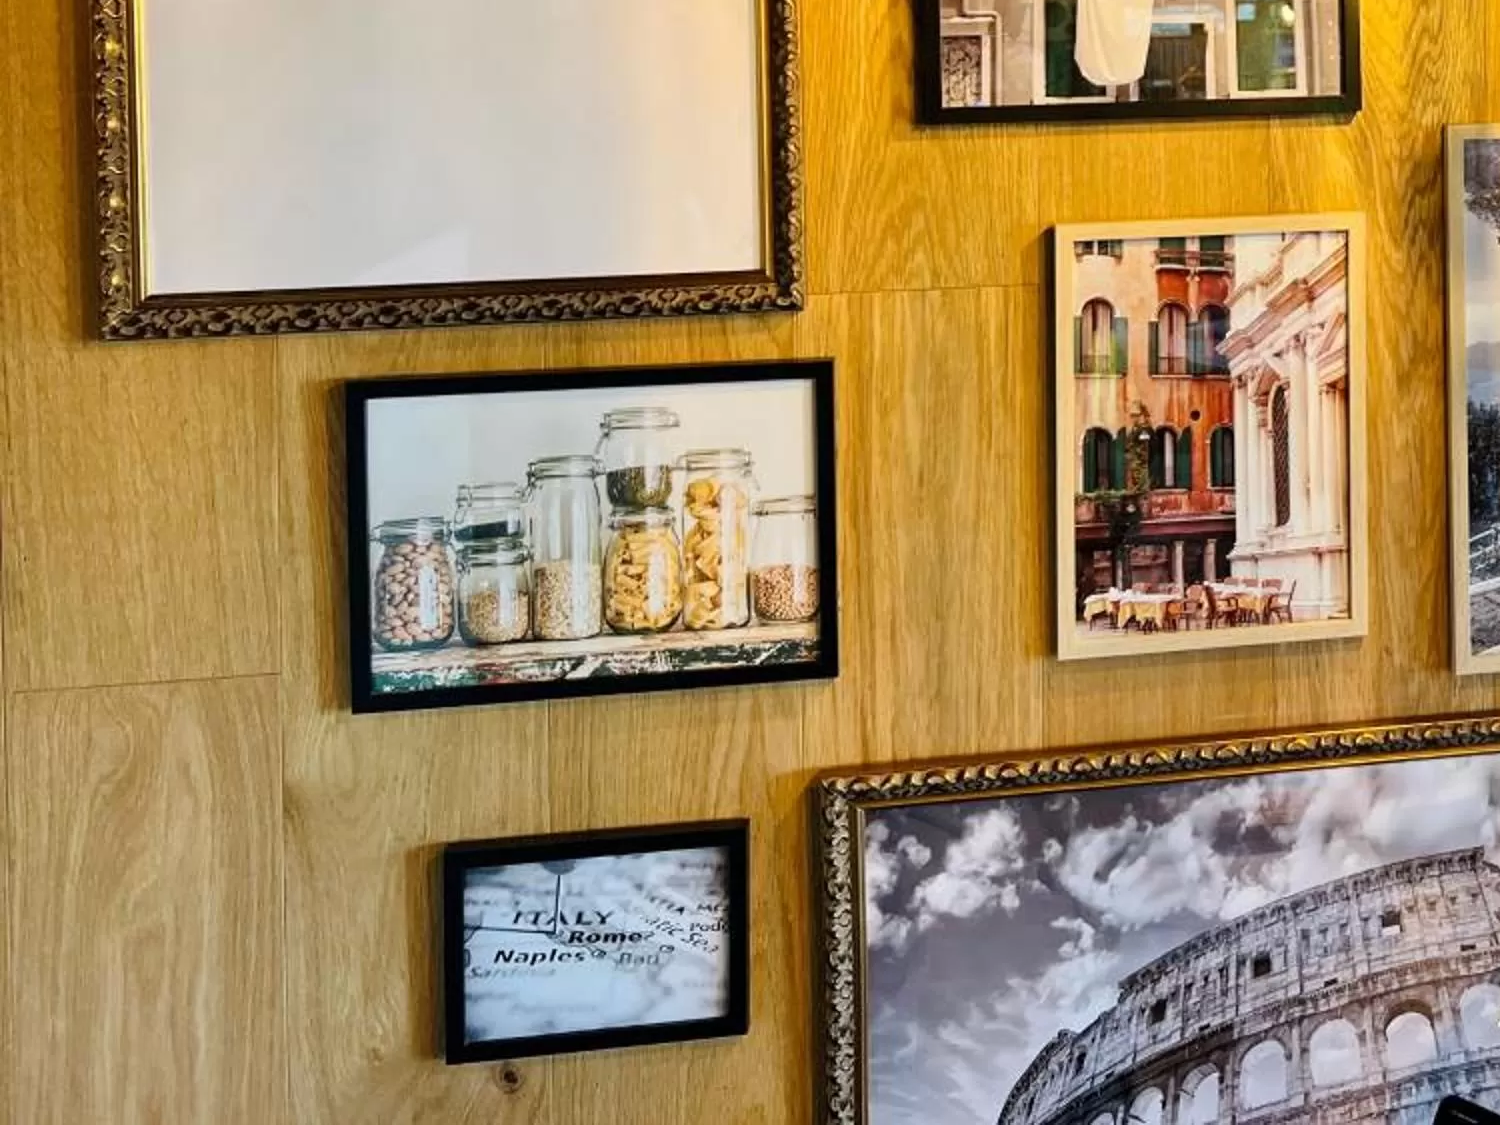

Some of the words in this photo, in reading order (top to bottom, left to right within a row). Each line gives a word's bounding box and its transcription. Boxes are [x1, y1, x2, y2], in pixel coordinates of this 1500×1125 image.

[512, 910, 614, 926] ITALY
[567, 931, 642, 944] Rome
[493, 948, 585, 966] Naples
